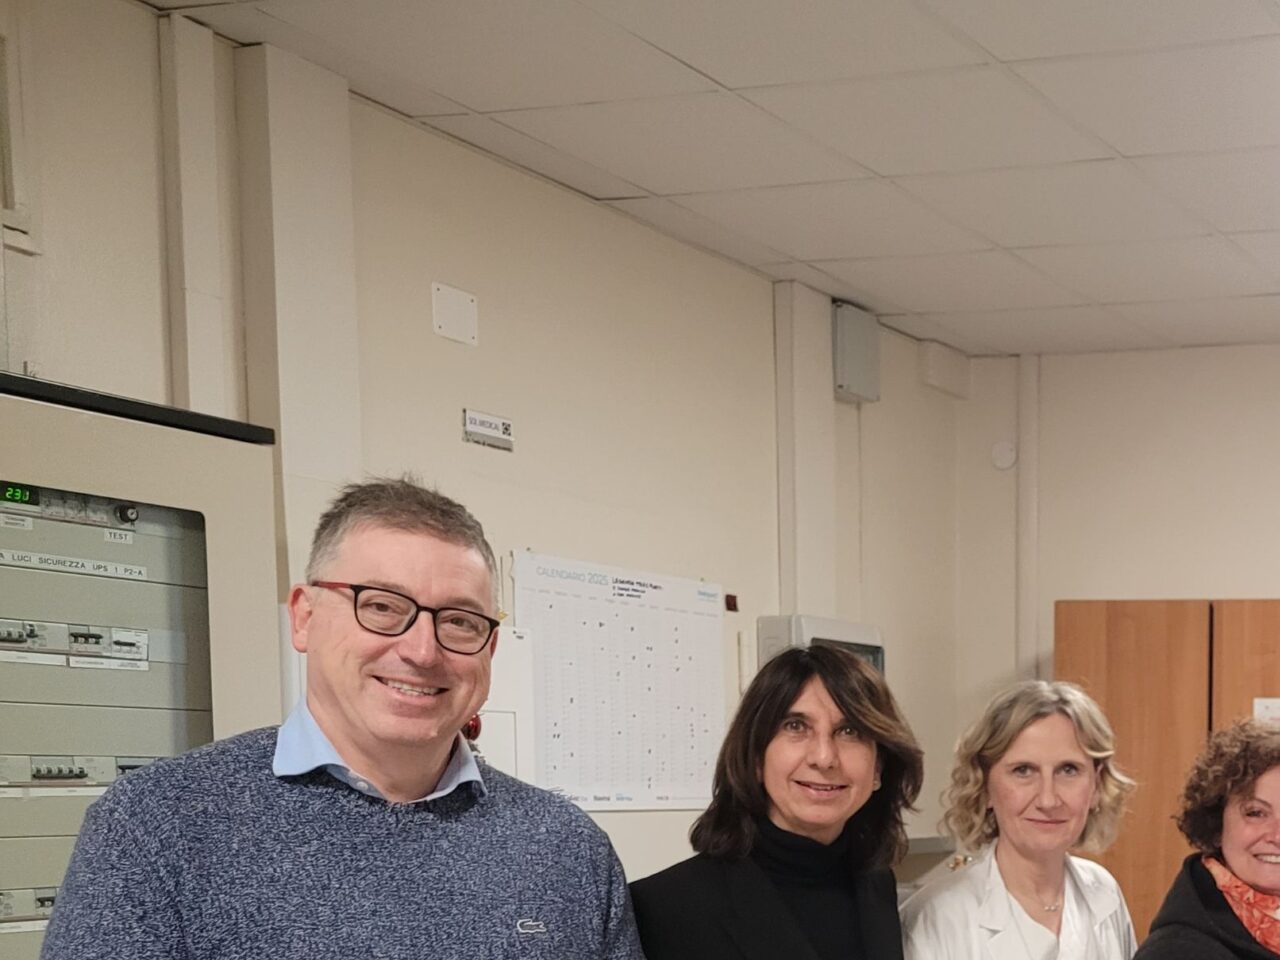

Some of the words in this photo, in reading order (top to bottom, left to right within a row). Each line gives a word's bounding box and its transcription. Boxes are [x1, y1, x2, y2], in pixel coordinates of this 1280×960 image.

[108, 531, 128, 541] TEST
[11, 554, 32, 563] LUCI
[38, 556, 86, 570] SICUREZZA
[92, 563, 108, 572] UPS
